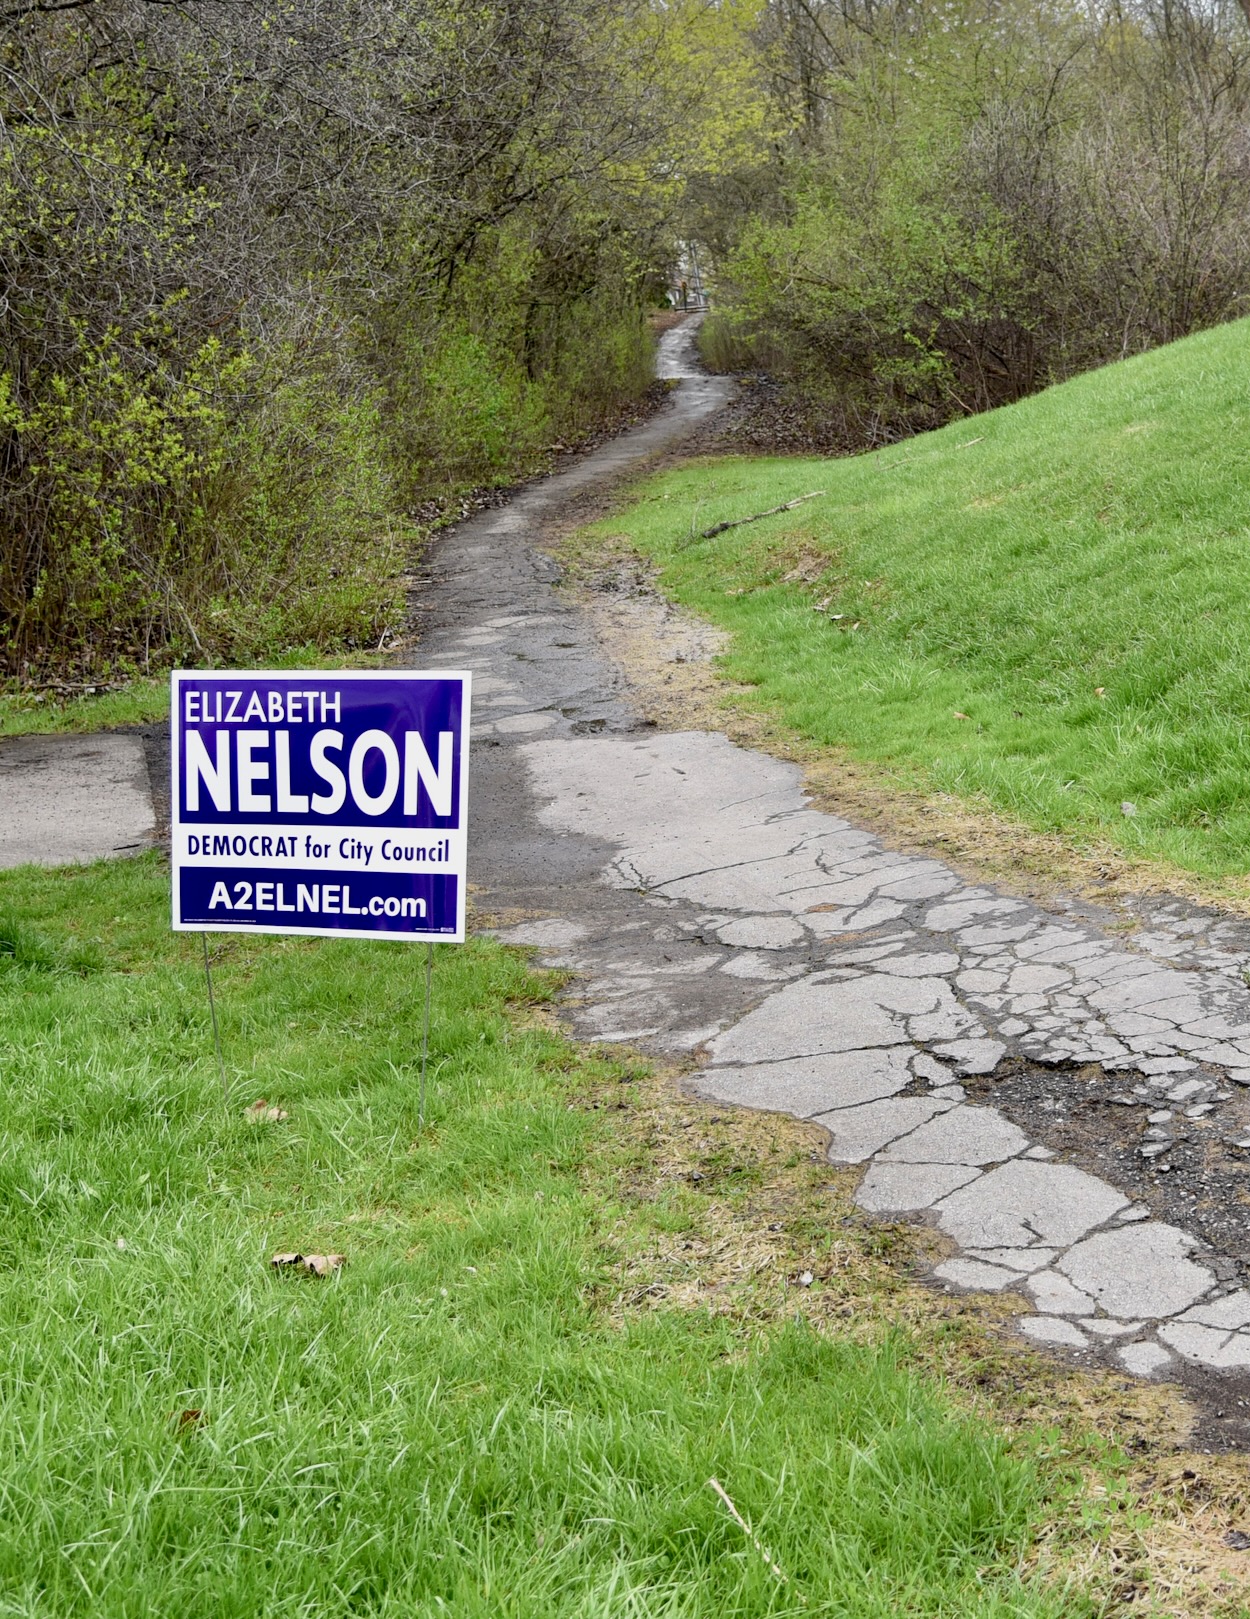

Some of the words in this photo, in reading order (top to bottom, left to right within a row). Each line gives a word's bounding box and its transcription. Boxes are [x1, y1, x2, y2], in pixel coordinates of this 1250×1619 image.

[185, 691, 341, 723] ELIZABETH
[185, 729, 454, 817] NELSON
[188, 835, 297, 857] DEMOCRAT
[305, 835, 331, 858] for
[339, 838, 373, 866] City
[381, 839, 449, 862] Council
[208, 881, 426, 918] A2ELNEL.com
